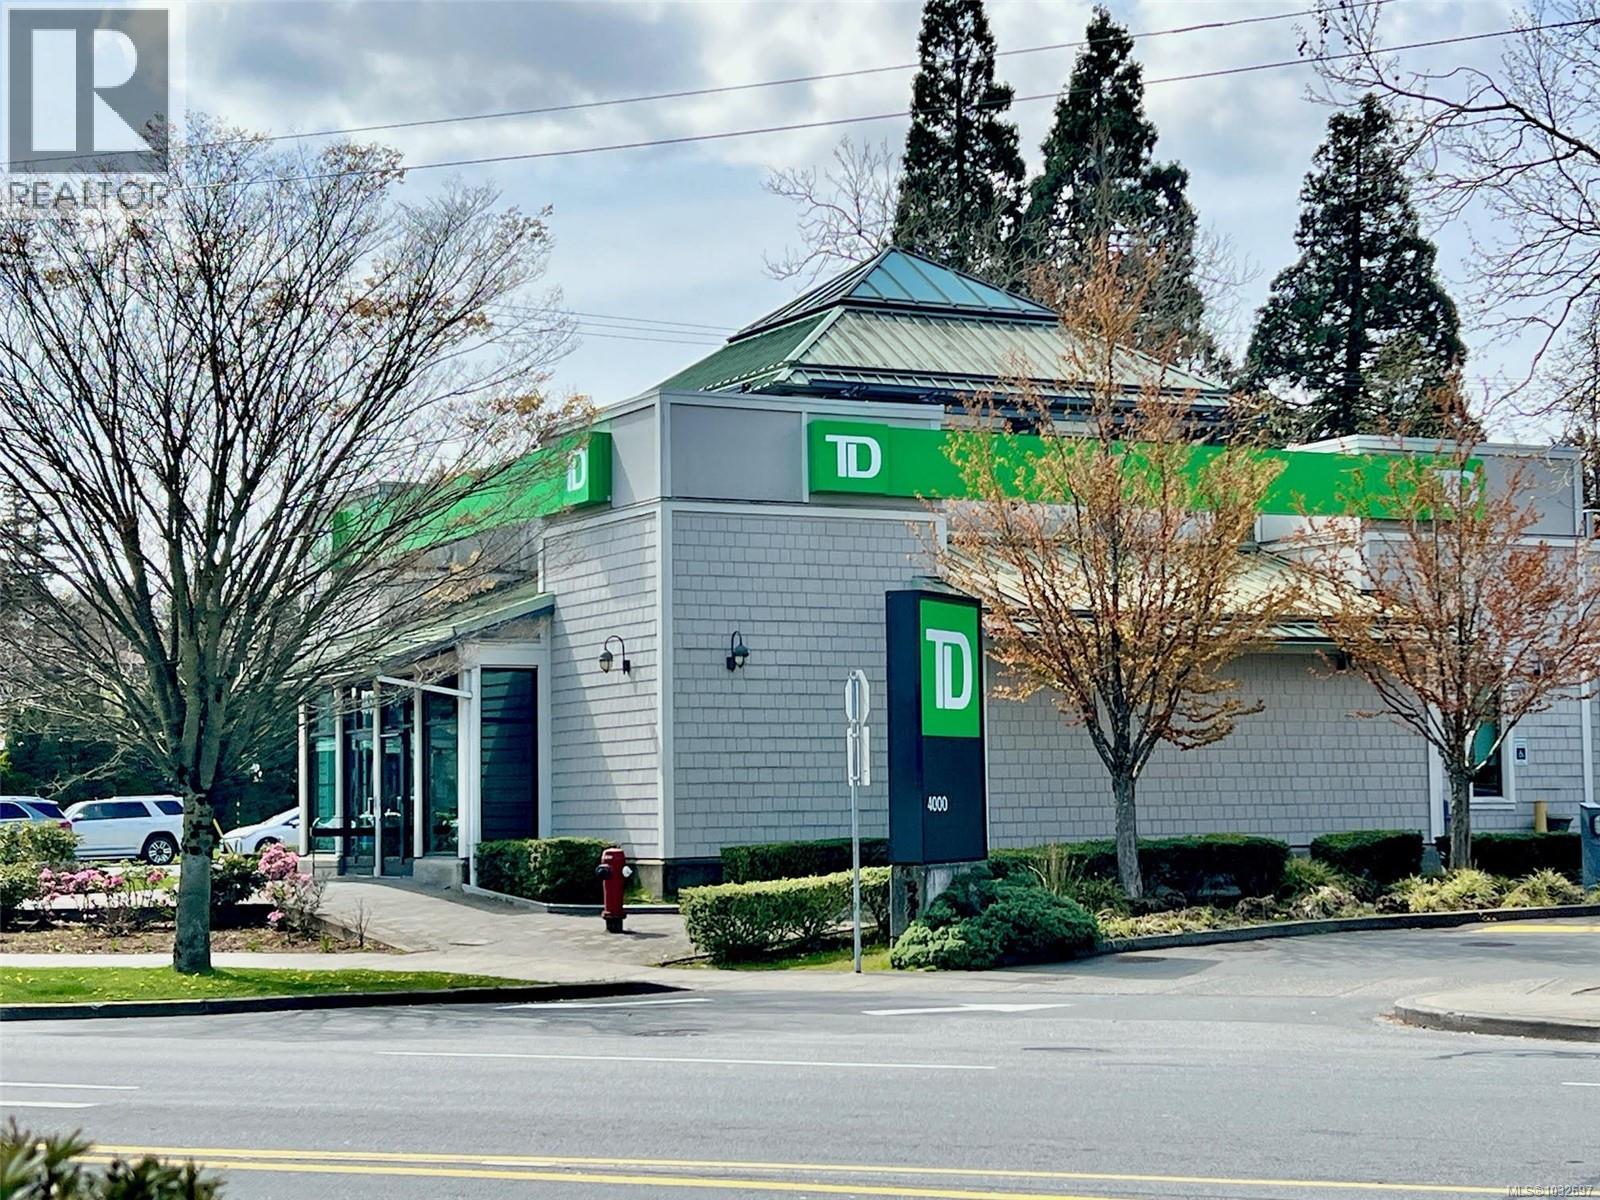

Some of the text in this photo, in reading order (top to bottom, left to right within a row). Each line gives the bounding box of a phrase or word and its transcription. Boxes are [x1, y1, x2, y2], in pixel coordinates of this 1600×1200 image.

[825, 434, 882, 479] TD
[926, 628, 973, 710] TD
[927, 795, 948, 812] 4000
